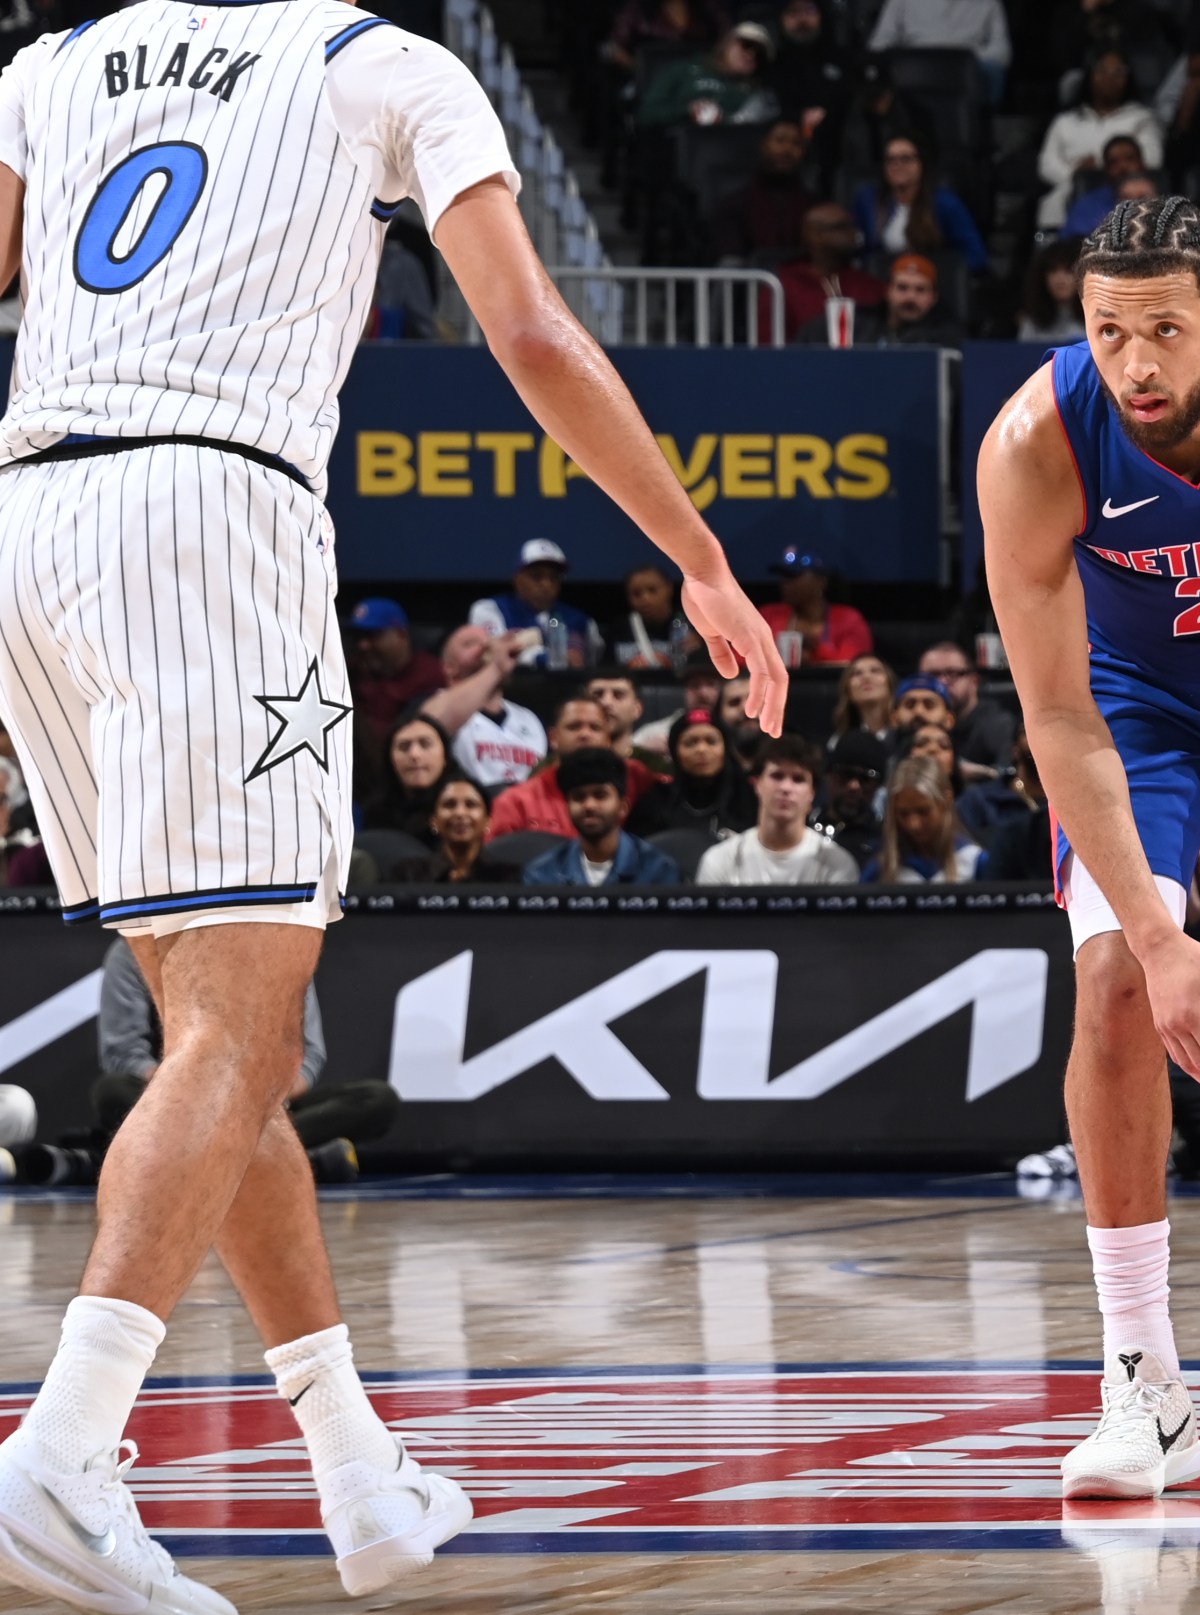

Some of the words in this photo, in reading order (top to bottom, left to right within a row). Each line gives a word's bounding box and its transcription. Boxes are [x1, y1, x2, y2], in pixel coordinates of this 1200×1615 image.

[104, 42, 262, 103] BLACK
[73, 140, 208, 295] 0
[356, 430, 891, 511] BETVERS
